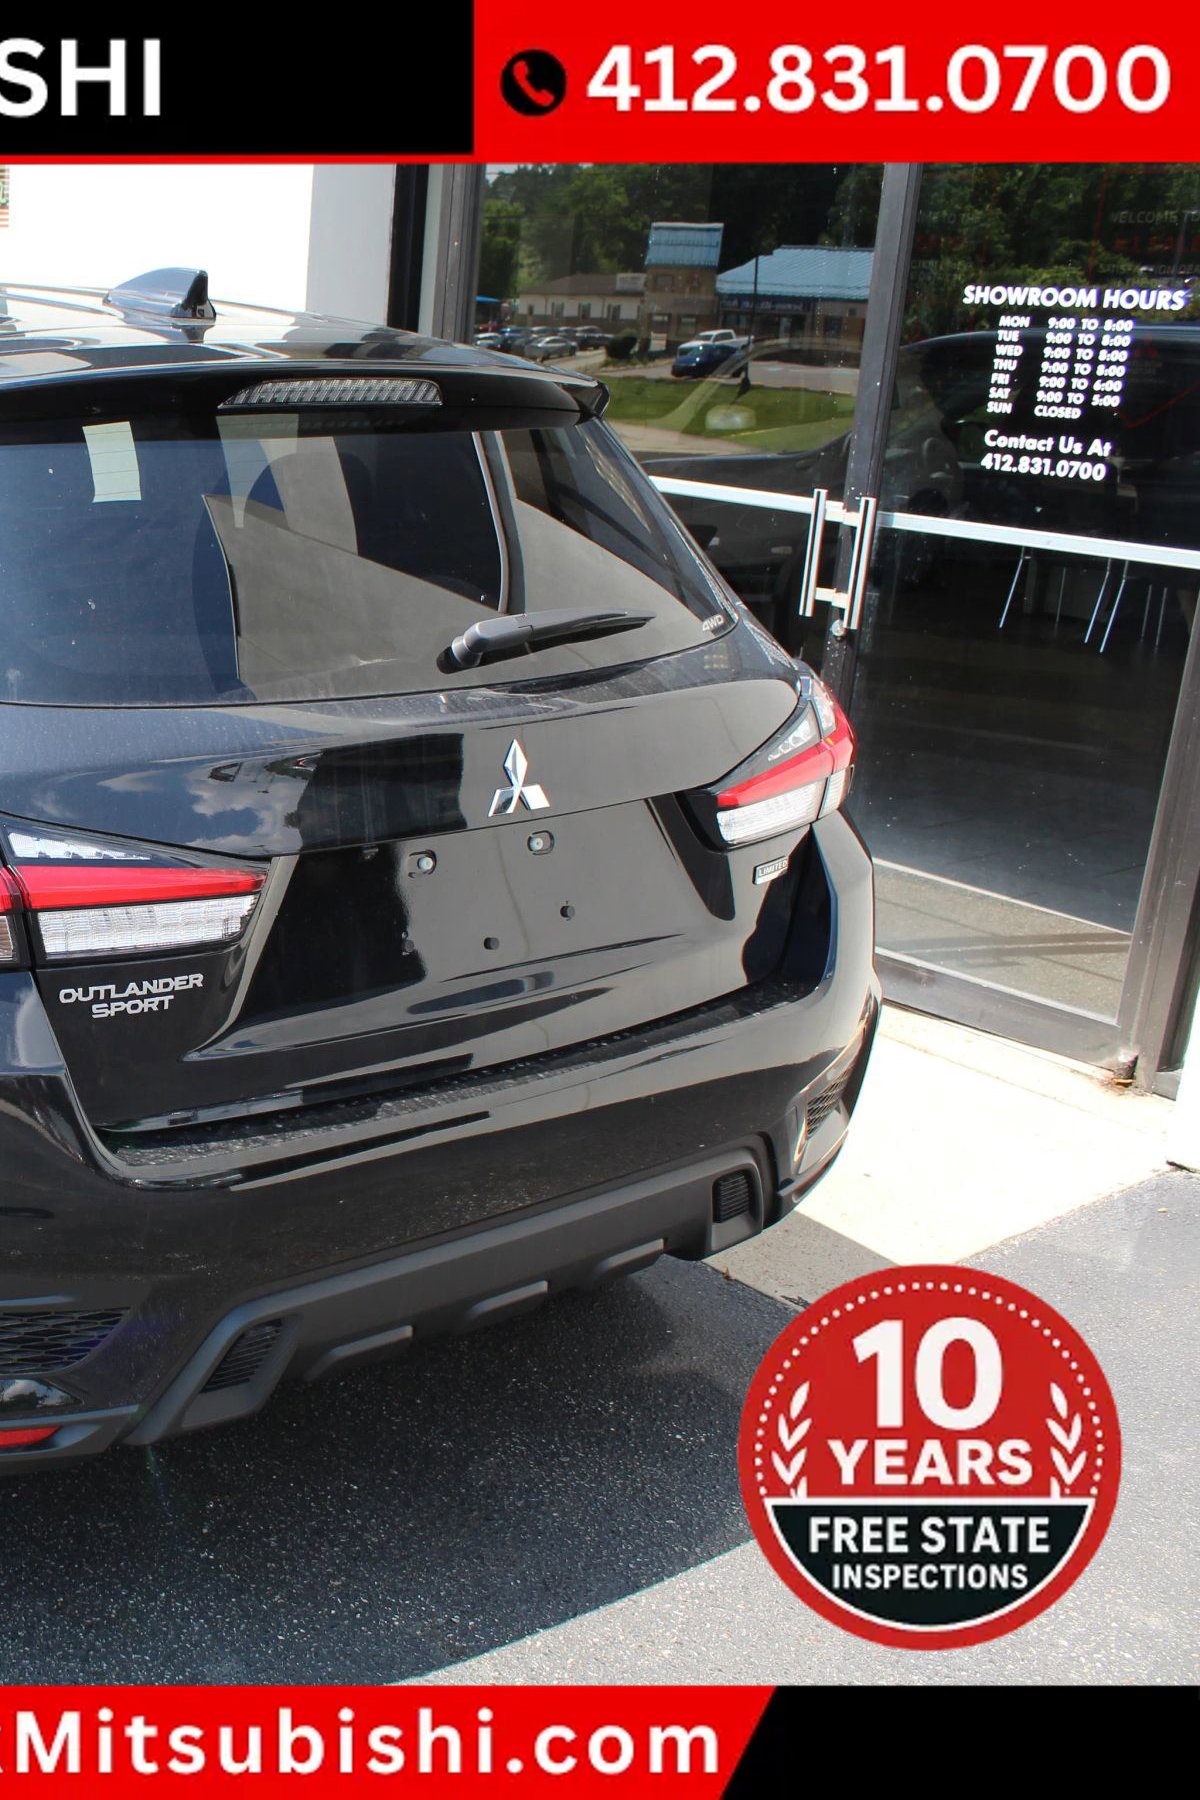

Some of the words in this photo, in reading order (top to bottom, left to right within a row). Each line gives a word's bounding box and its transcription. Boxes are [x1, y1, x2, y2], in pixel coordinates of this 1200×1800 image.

[963, 285, 1096, 307] SHOWROOM
[1103, 289, 1187, 310] HOURS
[999, 316, 1030, 327] MON
[1048, 317, 1075, 329] 9:00
[1082, 319, 1098, 330] TO
[1104, 319, 1133, 332] 8:00
[998, 330, 1019, 341] TUE
[1046, 332, 1072, 344] 9:00
[1078, 333, 1095, 345] TO
[1102, 334, 1131, 347] 8:00
[996, 345, 1023, 356] WED
[1044, 347, 1070, 359] 9:00
[1077, 349, 1093, 360] TO
[1099, 350, 1127, 362] 8:00
[994, 359, 1017, 370] THU
[1042, 362, 1068, 373] 9:00
[1074, 363, 1091, 375] TO
[1096, 364, 1125, 377] 8:00
[991, 373, 1009, 384] FRI
[1039, 376, 1065, 388] 9:00
[1072, 378, 1088, 390] TO
[1093, 380, 1122, 392] 6:00
[989, 387, 1010, 399] SAT
[1037, 391, 1062, 403] 9:00
[1067, 393, 1084, 404] TO
[1092, 394, 1120, 407] 5:00
[987, 401, 1012, 413] SUN
[1035, 405, 1081, 418] CLOSED
[985, 430, 1053, 451] Contact
[1059, 436, 1082, 454] Us
[1087, 439, 1111, 456] At
[981, 453, 1105, 480] 412.831.0700
[703, 615, 724, 631] 4WD
[60, 974, 203, 1003] OUTLANDER
[92, 995, 174, 1018] SPORT
